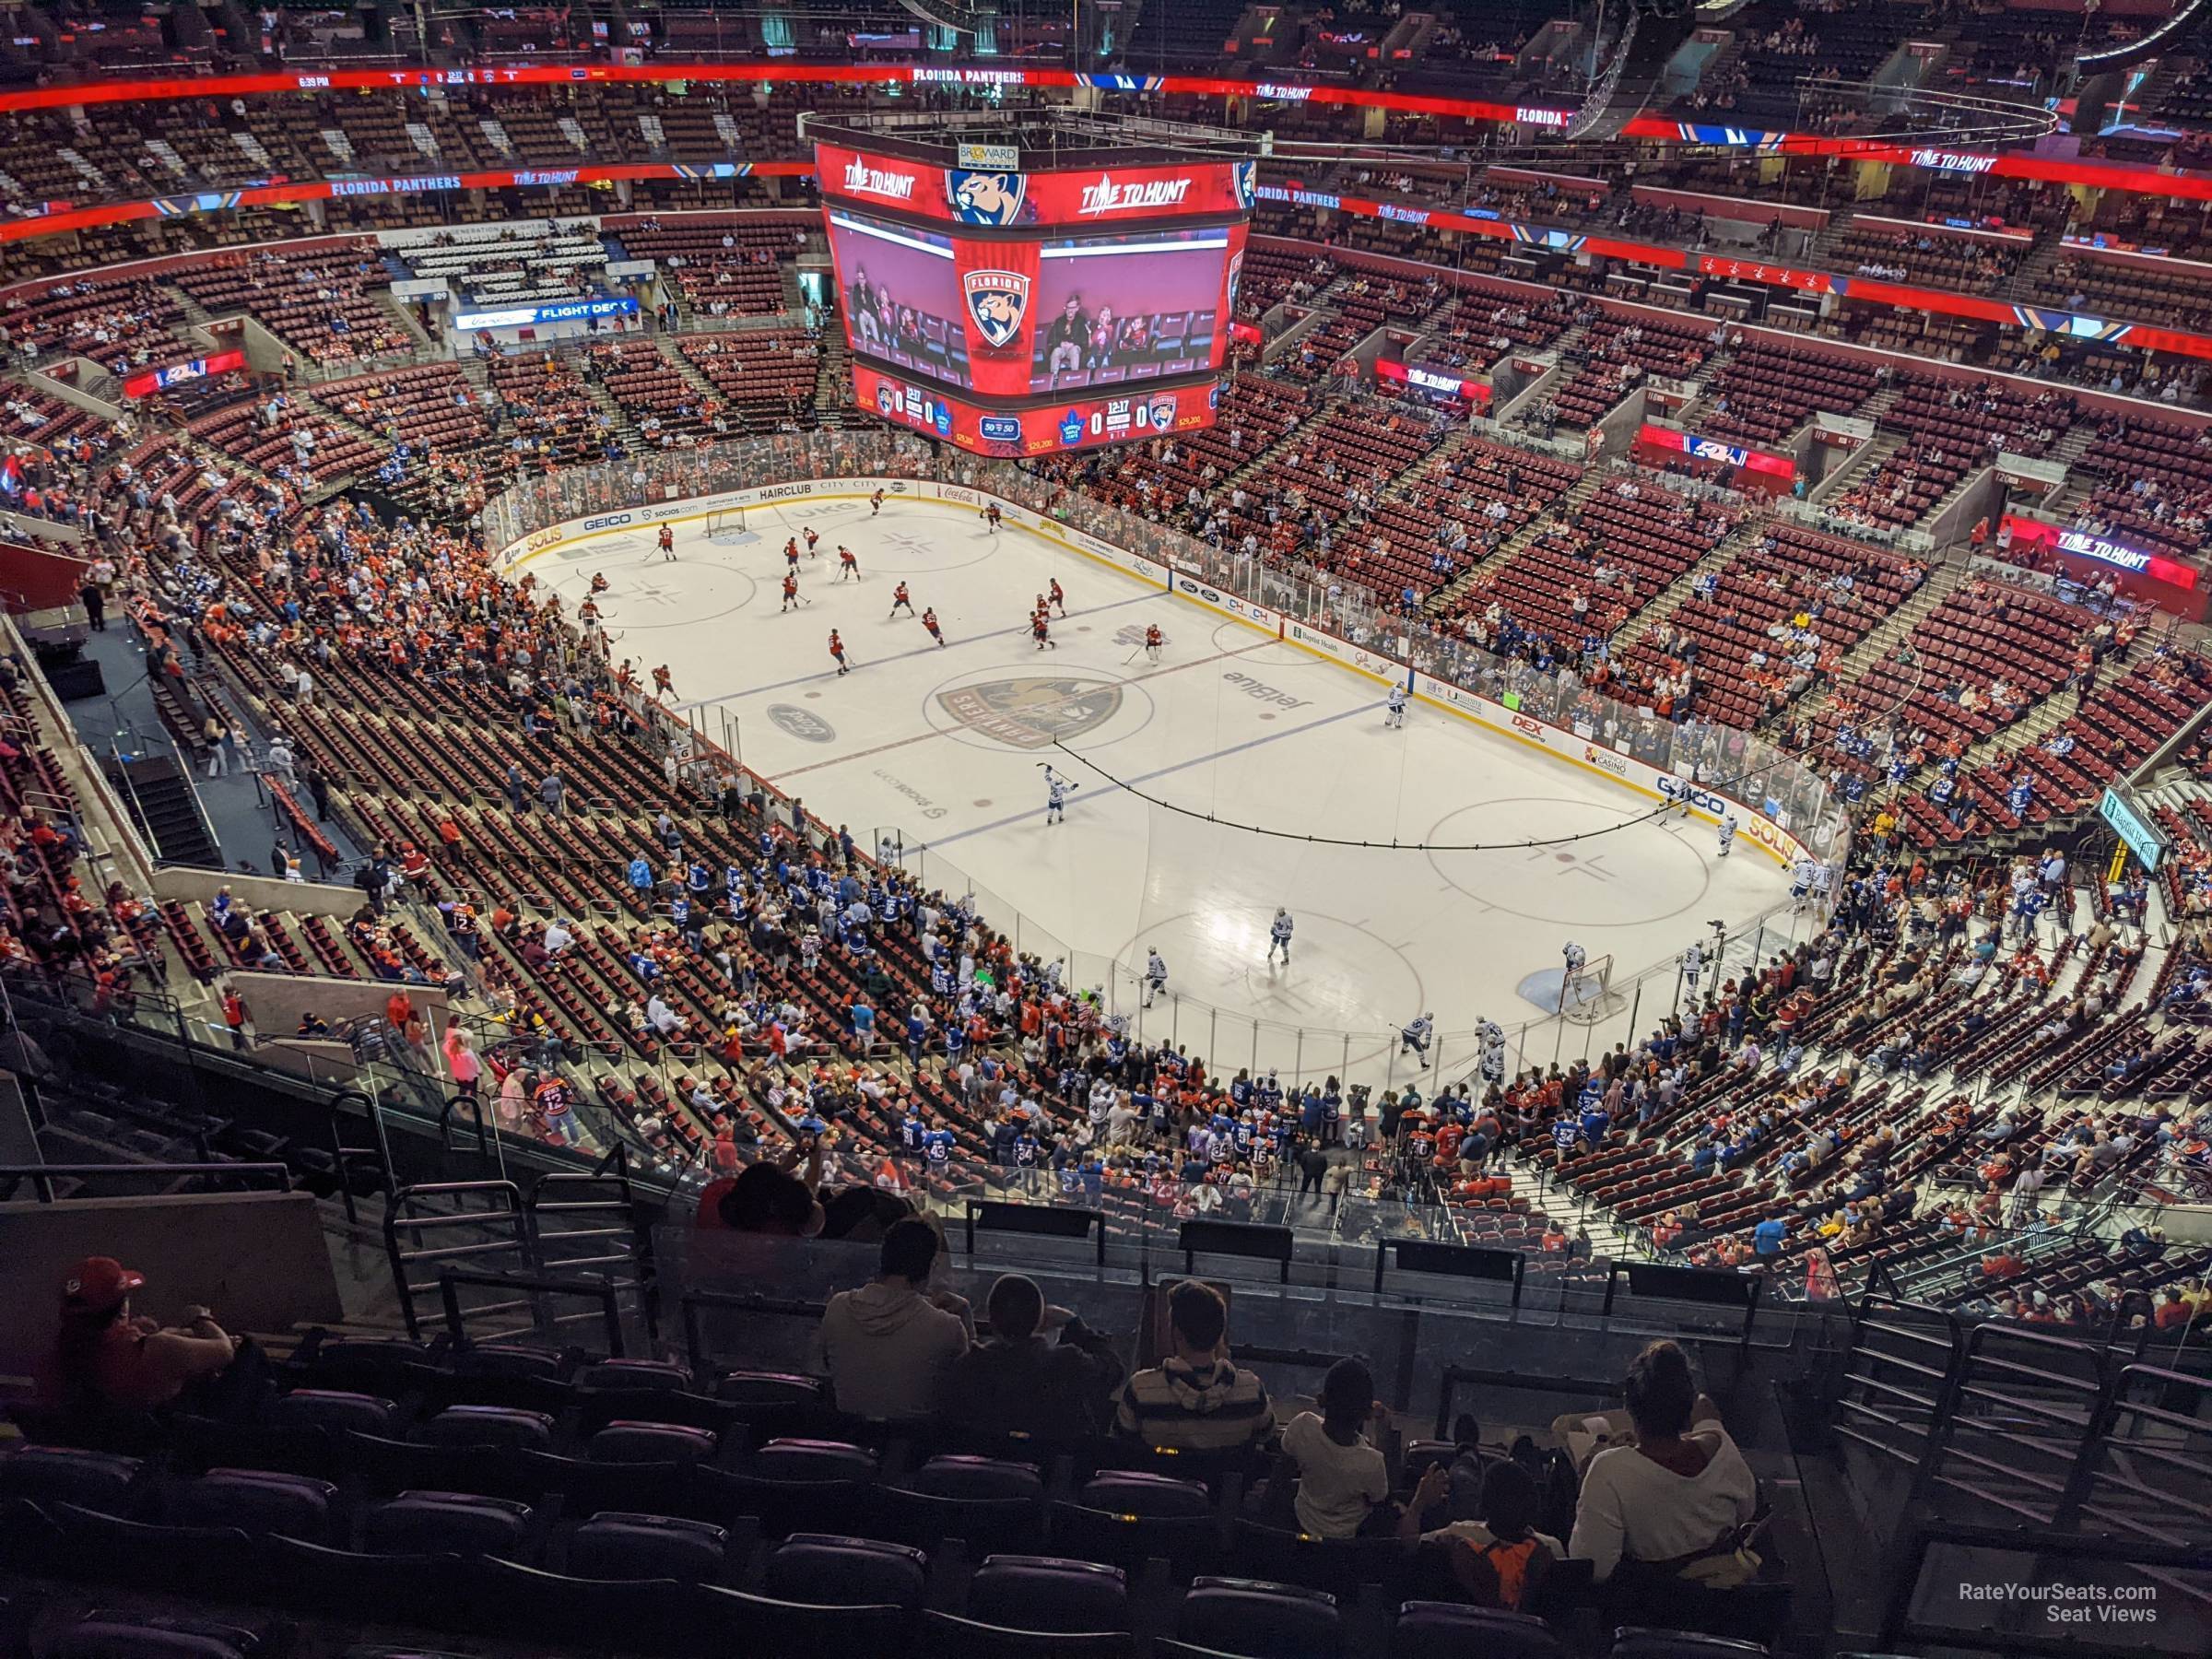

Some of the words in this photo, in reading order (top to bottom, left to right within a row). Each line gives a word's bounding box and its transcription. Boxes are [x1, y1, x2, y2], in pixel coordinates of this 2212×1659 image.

[299, 76, 316, 88] 6:39
[317, 76, 329, 87] PM
[913, 69, 962, 83] FLORIDA
[966, 70, 1025, 84] PANTHERS
[1255, 83, 1276, 97] TIME
[1276, 87, 1288, 98] TO
[1287, 88, 1312, 100] HUNT
[1516, 108, 1562, 125] FLORIDA
[960, 147, 1017, 159] BROWARD
[1910, 149, 1939, 167] TIME
[1942, 154, 1959, 168] TO
[1957, 156, 1997, 172] HUNT
[332, 180, 389, 195] FLORIDA
[394, 176, 461, 192] PANTHERS
[513, 171, 537, 184] TIME
[537, 172, 551, 183] TO
[549, 170, 579, 183] HUNT
[845, 159, 868, 189] TIME
[870, 169, 883, 190] TO
[882, 172, 915, 199] HUNT
[1082, 179, 1117, 210] TIME
[1124, 187, 1144, 205] TO
[1145, 179, 1192, 204] HUNT
[1253, 188, 1289, 200] ORIDA
[1293, 190, 1340, 208] PANTHERS
[1377, 204, 1395, 218] TIME
[1396, 208, 1408, 221] TO
[1406, 210, 1430, 224] HUNT
[971, 277, 1020, 290] FLORIDA
[433, 292, 447, 300] 109
[542, 304, 588, 319] FLIGHT
[1407, 368, 1428, 382] TIME
[1428, 373, 1438, 385] TO
[1437, 376, 1464, 392] HUNT
[895, 391, 903, 412] 0
[925, 401, 933, 424] 0
[1108, 400, 1130, 415] 12:17
[984, 423, 994, 432] 50
[1003, 424, 1014, 432] 50
[1091, 412, 1102, 435] 0
[1135, 406, 1147, 428] 0
[1179, 415, 1201, 427] $29,200
[1814, 429, 1828, 441] 119
[1853, 438, 1864, 448] 12
[759, 484, 811, 500] HAIRCLUB
[820, 480, 844, 488] CITY
[853, 479, 877, 488] CITY
[2042, 483, 2053, 493] 12
[791, 502, 858, 518] UKG
[583, 513, 631, 531] GEICO
[527, 526, 562, 551] SOLIS
[2058, 532, 2093, 550] TIME
[2094, 540, 2112, 556] TO
[2111, 545, 2152, 570] HUNT
[1202, 590, 1218, 602] Ford
[1229, 598, 1244, 612] CH
[1253, 608, 1268, 622] CH
[1302, 631, 1322, 645] Baptist
[1322, 639, 1338, 653] Health
[1222, 672, 1314, 712] jetBlue
[779, 711, 827, 735] Ford
[952, 695, 1042, 743] PANTHERS
[1512, 714, 1545, 735] DEX
[1518, 727, 1547, 743] imaging
[1597, 756, 1627, 773] CASINO
[1656, 776, 1725, 816] GICO
[1748, 814, 1802, 861] SOLIS
[2113, 809, 2136, 841] Baptist
[2135, 831, 2154, 861] Health
[544, 1093, 564, 1111] 12
[1238, 1132, 1251, 1144] 91
[1559, 1132, 1574, 1143] 34
[931, 1144, 945, 1159] 43
[1018, 1148, 1032, 1160] 34
[1252, 1149, 1268, 1163] 16
